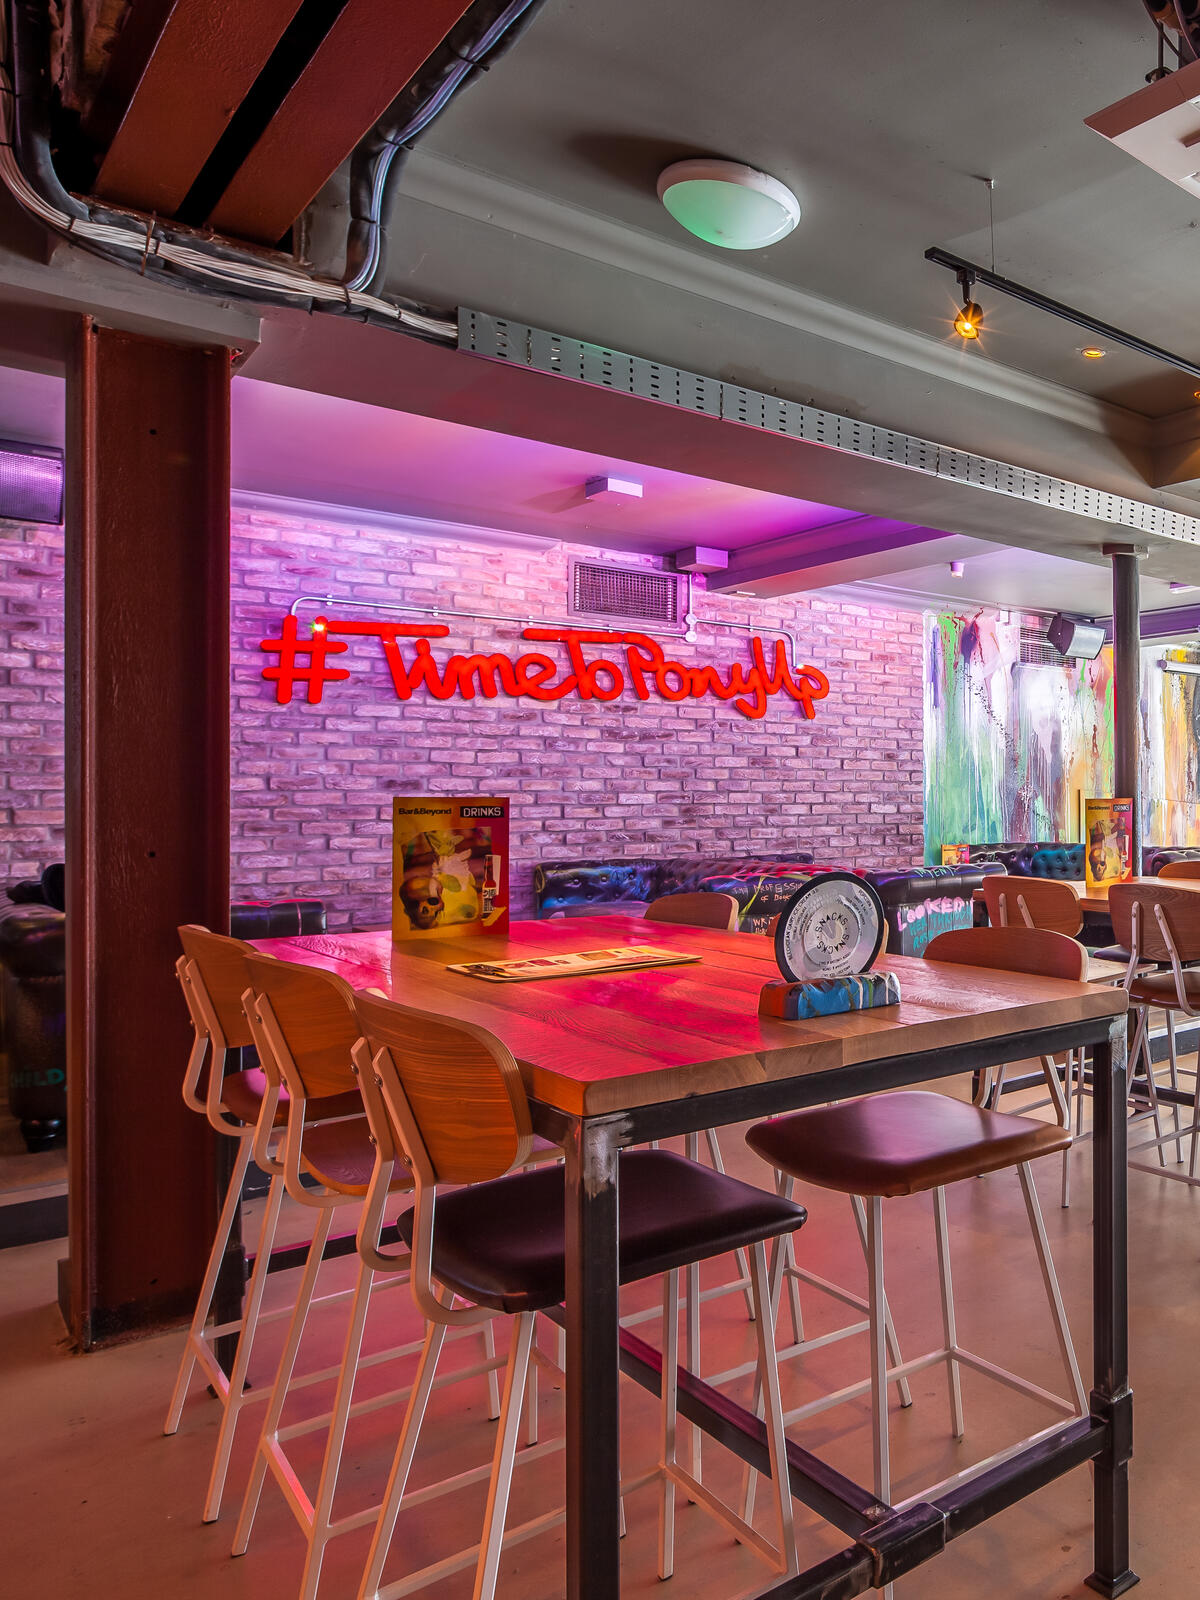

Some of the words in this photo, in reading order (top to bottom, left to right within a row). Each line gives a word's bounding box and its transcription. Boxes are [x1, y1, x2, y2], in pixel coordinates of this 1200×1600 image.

[398, 807, 452, 817] Bar&Beyond
[463, 806, 501, 817] DRINKS
[815, 912, 848, 933] SNACKS
[816, 933, 850, 955] SNACKS
